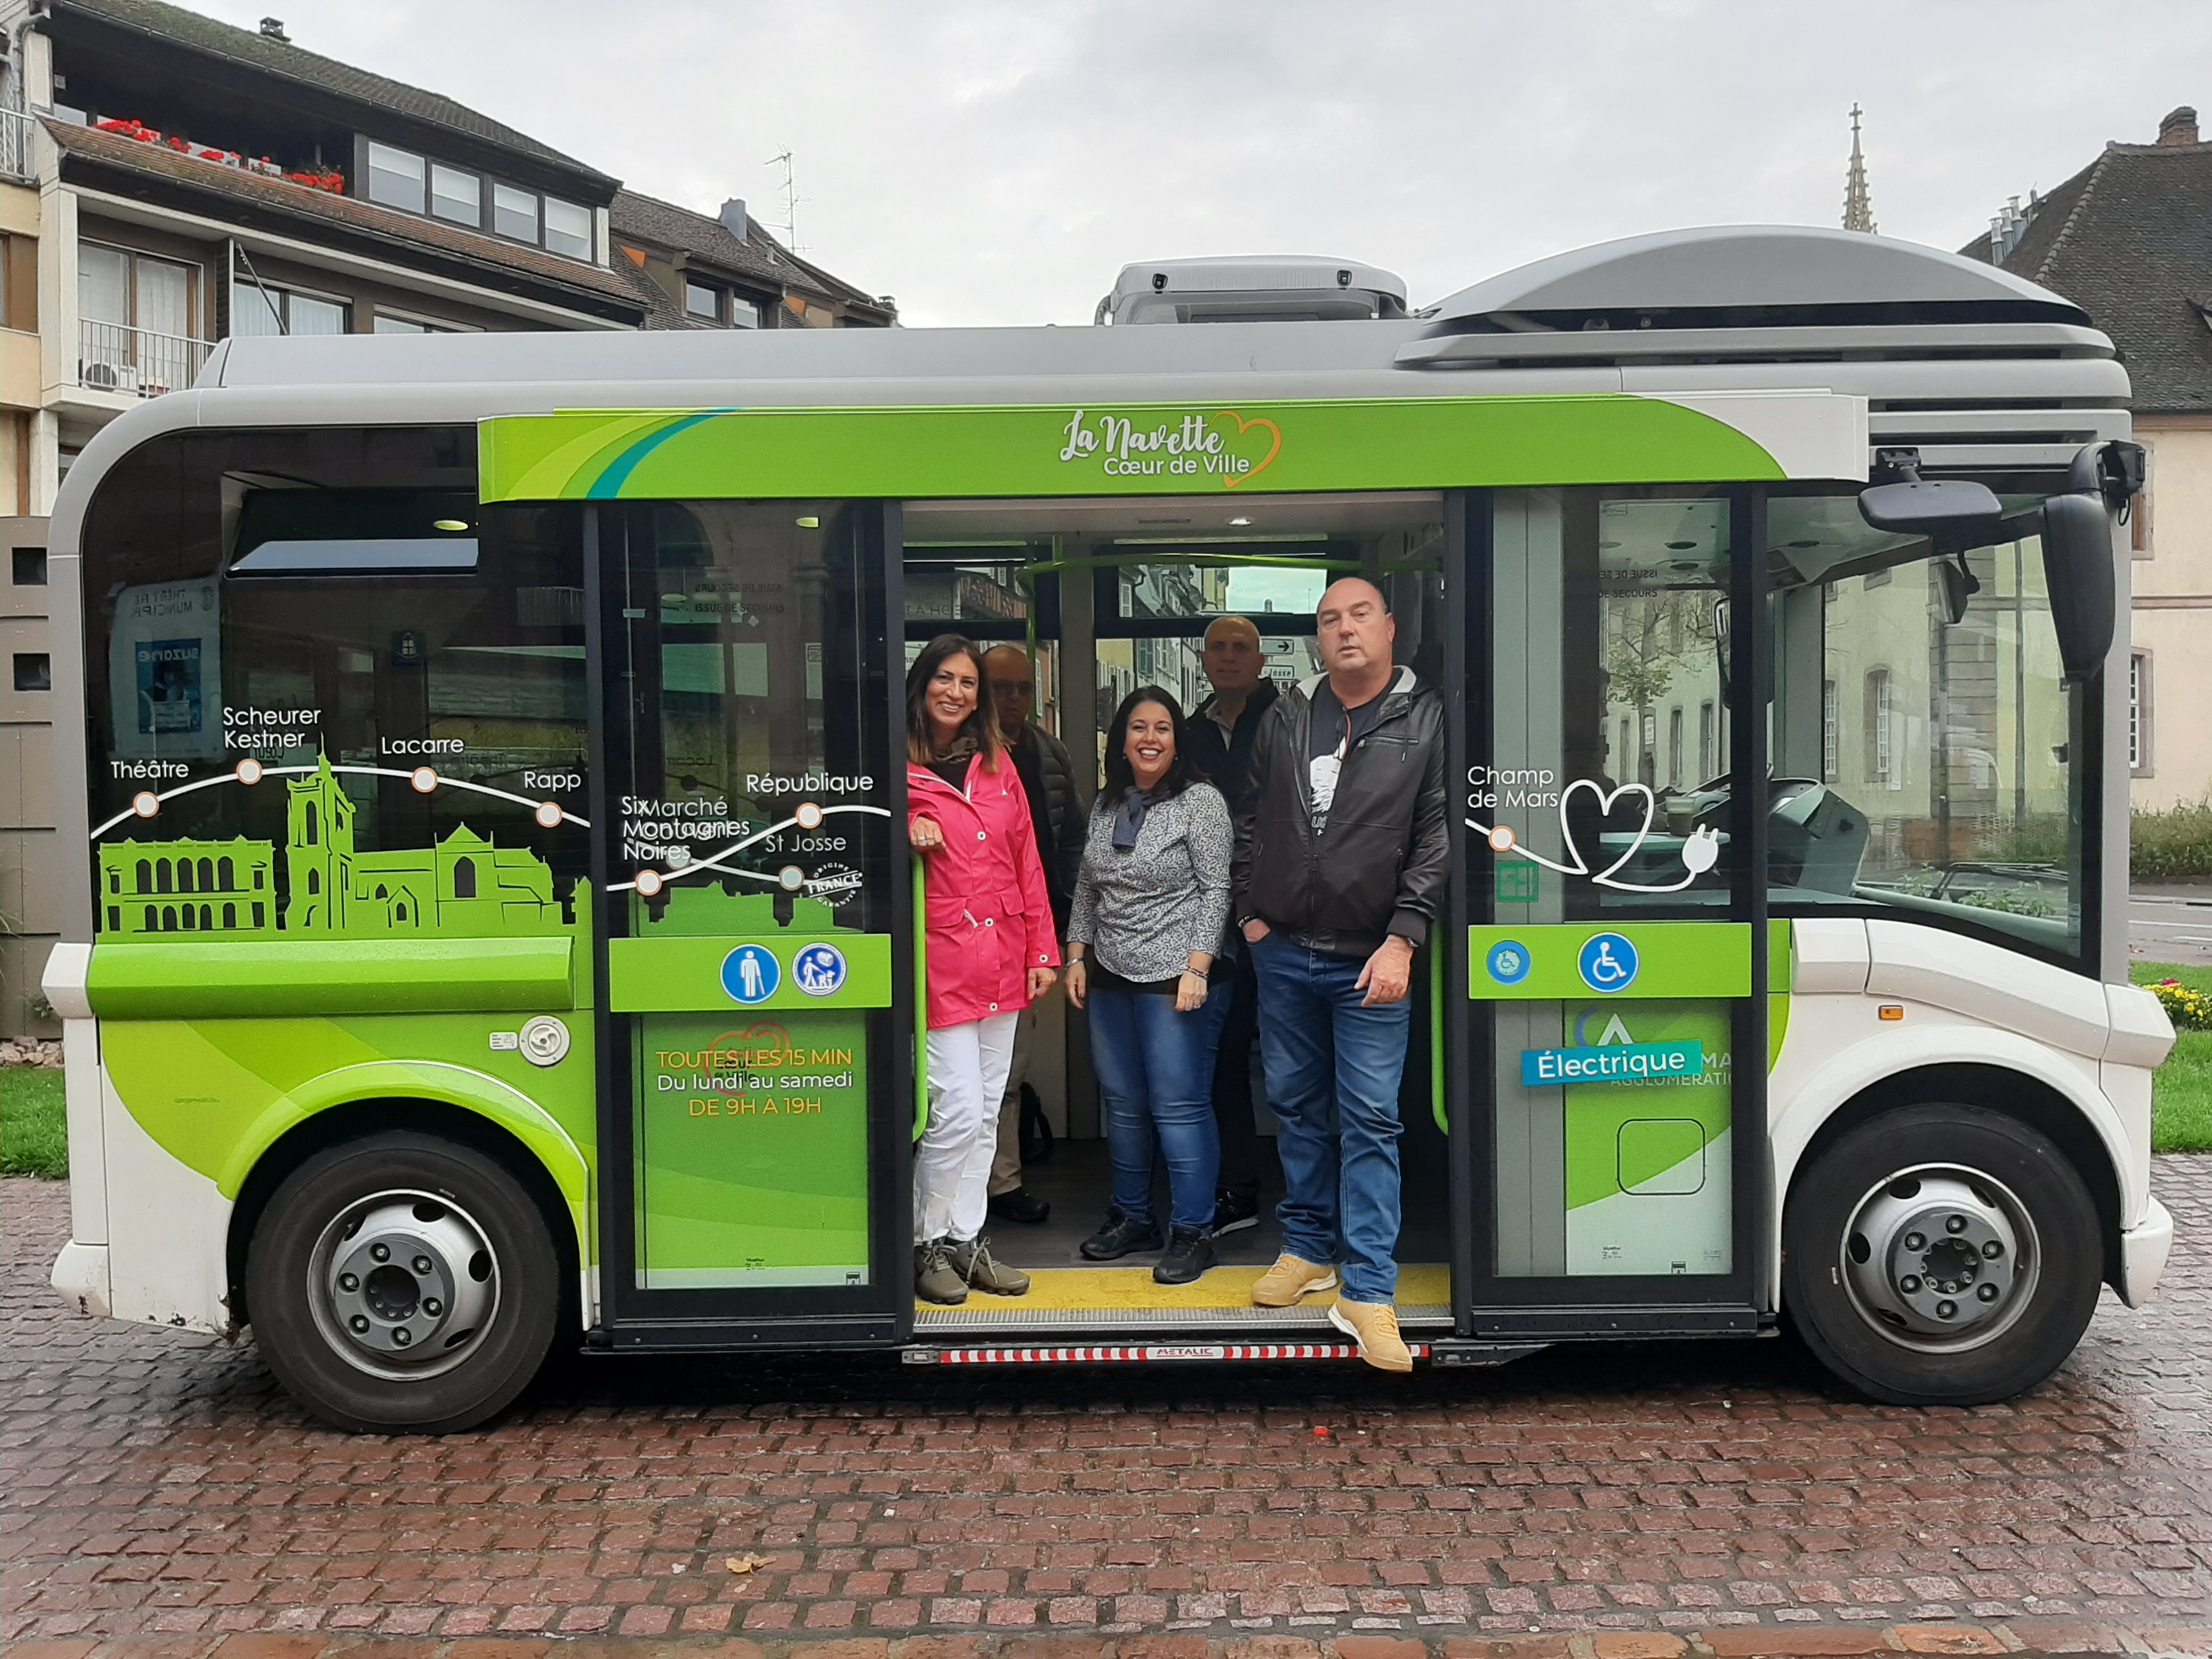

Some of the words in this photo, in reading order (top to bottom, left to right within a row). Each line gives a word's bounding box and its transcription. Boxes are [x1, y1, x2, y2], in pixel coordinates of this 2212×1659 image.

[1060, 409, 1099, 461] La
[1099, 415, 1224, 459] Navette
[1104, 457, 1164, 475] Cœur
[1170, 455, 1197, 474] de
[1204, 454, 1250, 473] Ville
[1612, 589, 1658, 598] SECOURS
[222, 707, 321, 726] Scheurer
[224, 730, 305, 749] Kestner
[382, 737, 464, 755] Lacarre
[111, 761, 189, 779] Théâtre
[1468, 766, 1554, 788] Champ
[525, 772, 581, 792] Rapp
[747, 772, 873, 795] République
[622, 796, 650, 815] Six
[639, 796, 727, 817] Marché
[1468, 789, 1497, 808] de
[1505, 789, 1558, 808] Mars
[623, 818, 750, 840] Montagnes
[624, 840, 691, 861] Noires
[765, 834, 783, 853] St
[791, 834, 847, 852] Josse
[656, 1050, 739, 1069] TOUTES
[746, 1049, 782, 1068] LES
[787, 1049, 806, 1066] 15
[811, 1048, 853, 1066] MIN
[1538, 1050, 1686, 1078] Électrique
[658, 1075, 685, 1091] Du
[693, 1073, 743, 1090] lundi
[749, 1076, 774, 1090] au
[780, 1071, 853, 1088] samedi
[1610, 1072, 1731, 1086] AGGLOMERATI
[689, 1098, 720, 1117] DE
[726, 1097, 756, 1115] 9H
[761, 1093, 779, 1115] À
[783, 1097, 822, 1115] 19H
[1156, 1348, 1214, 1357] METALIC
